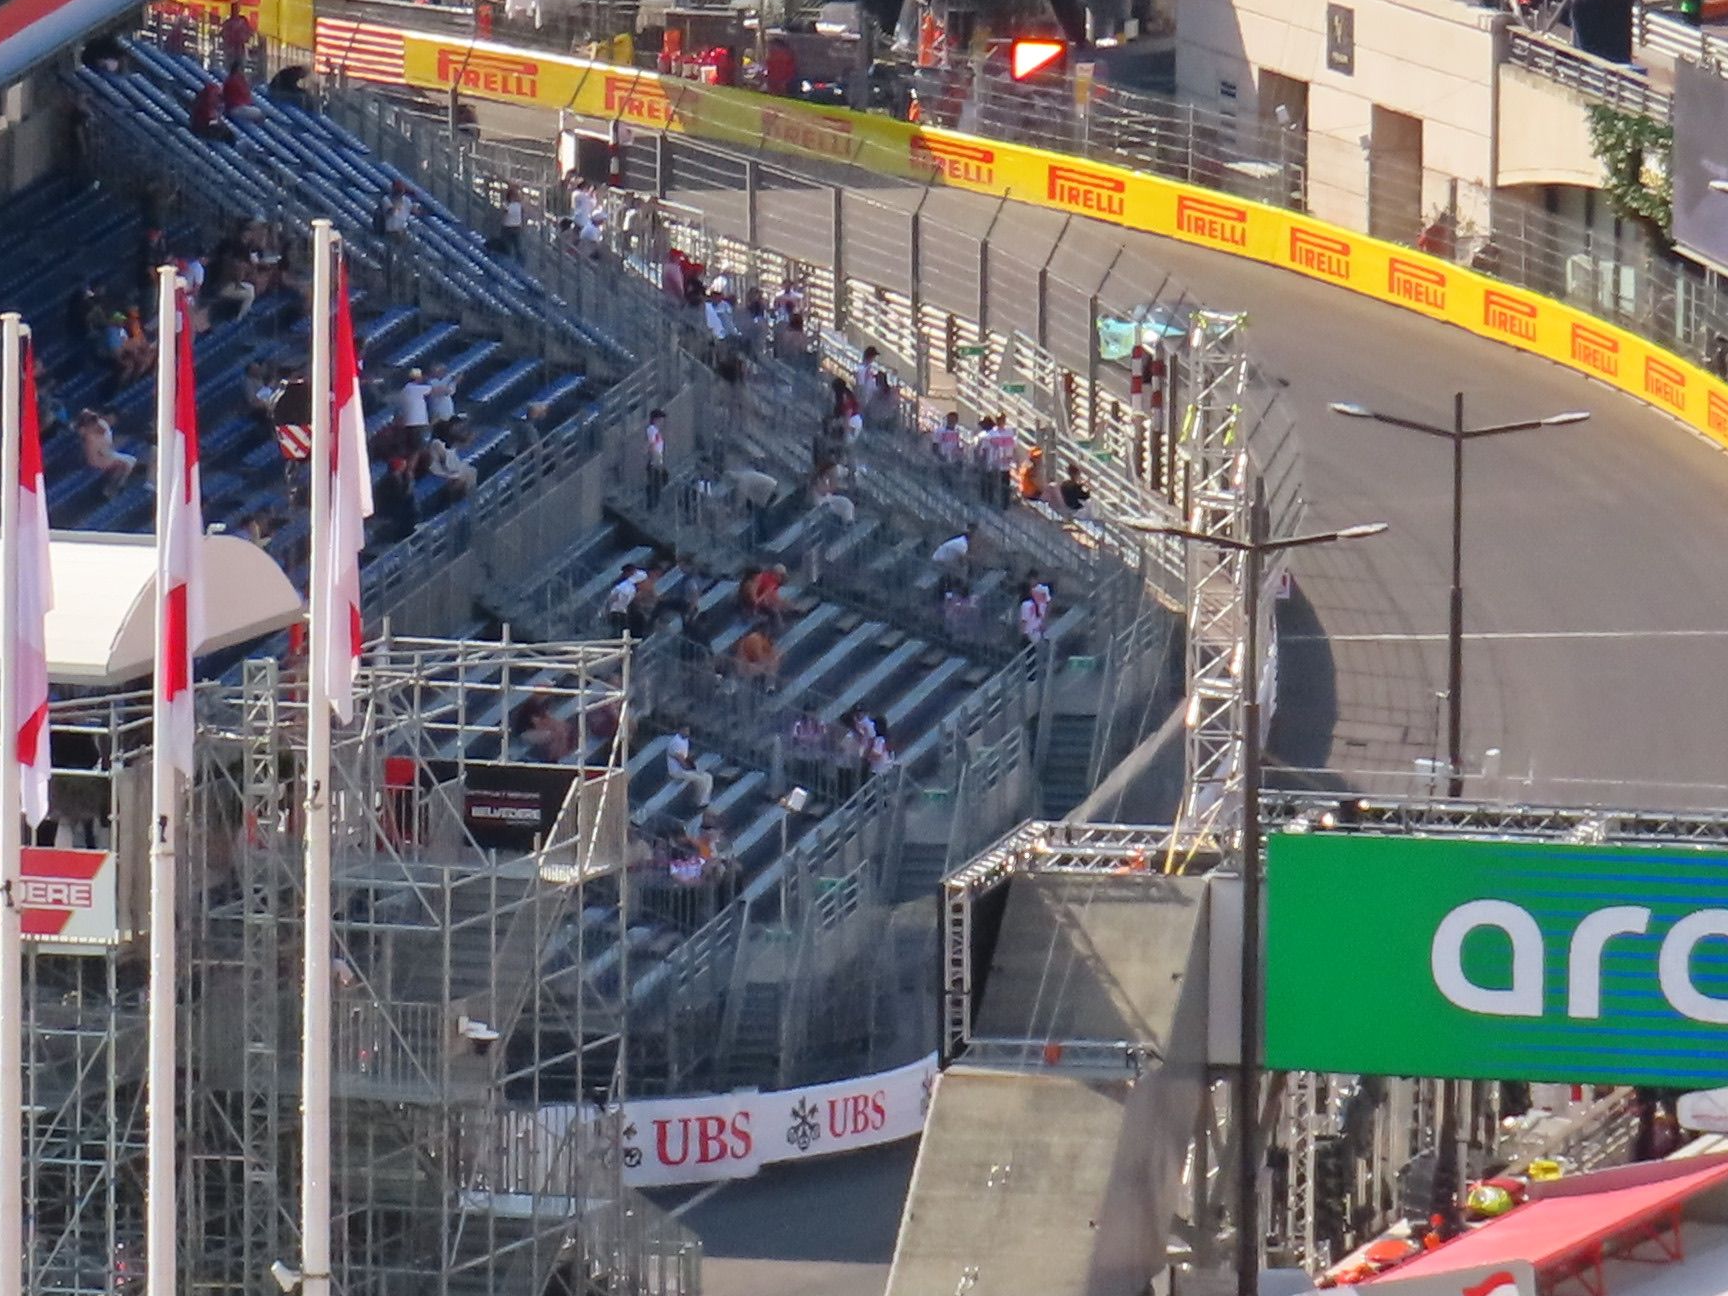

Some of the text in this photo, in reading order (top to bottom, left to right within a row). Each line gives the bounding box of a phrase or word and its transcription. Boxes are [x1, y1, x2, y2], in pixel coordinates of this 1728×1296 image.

[437, 48, 539, 98] PIRELLI
[1047, 164, 1125, 216] PIRELLI
[1176, 195, 1247, 247] PIRELLI
[1289, 226, 1351, 281] PIRELLI
[1388, 257, 1447, 311] PIRELLI
[1483, 289, 1537, 343] PIRELLI
[1570, 323, 1619, 377] PIRELLI
[1644, 355, 1686, 412] PIRELLI
[653, 1110, 753, 1167] UBS
[827, 1090, 886, 1138] UBS
